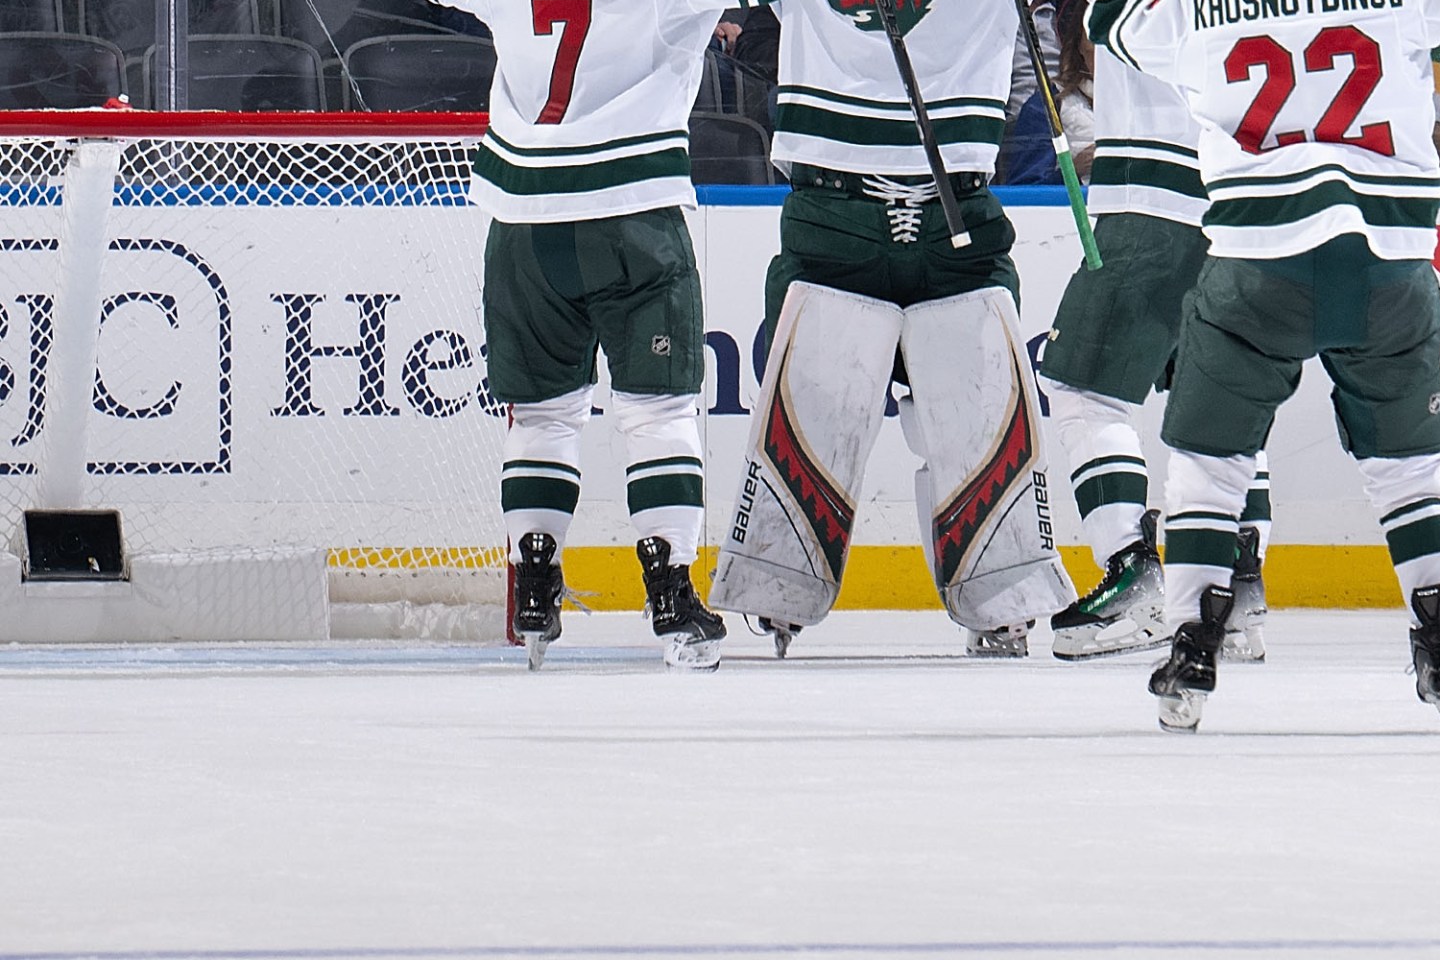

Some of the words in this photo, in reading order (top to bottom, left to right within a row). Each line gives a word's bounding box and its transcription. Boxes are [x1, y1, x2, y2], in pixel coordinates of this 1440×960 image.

[1224, 25, 1395, 156] 22
[0, 292, 182, 447] JC
[732, 461, 763, 544] BAUER
[1032, 465, 1056, 546] BAUER
